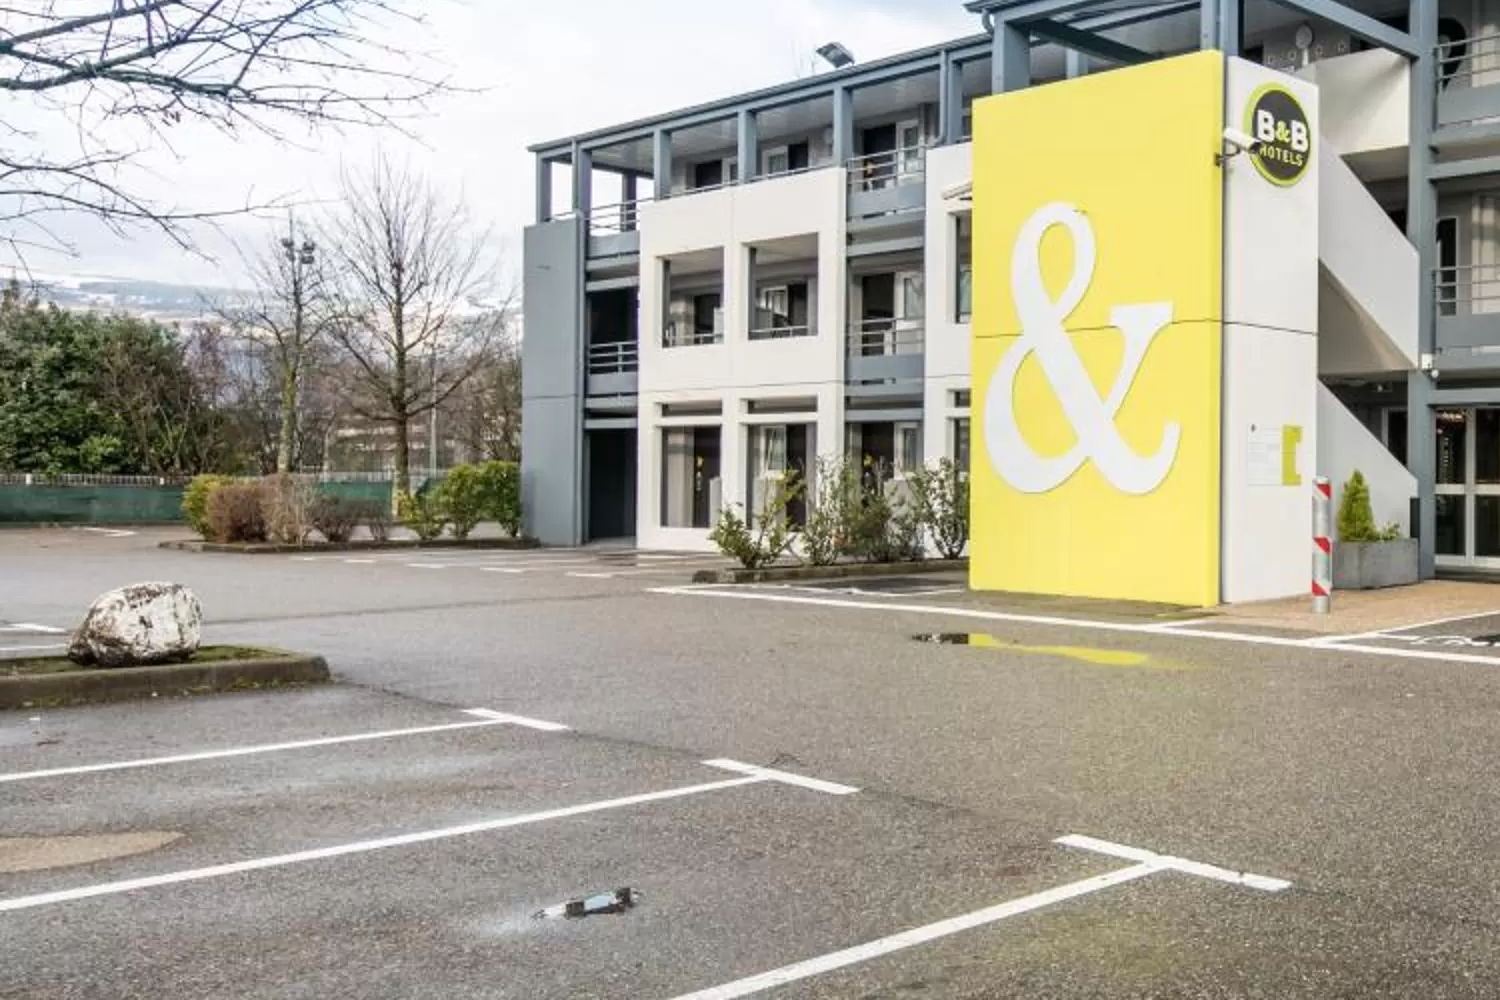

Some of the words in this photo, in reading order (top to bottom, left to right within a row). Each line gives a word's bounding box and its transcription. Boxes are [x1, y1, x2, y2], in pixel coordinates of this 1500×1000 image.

[1257, 109, 1309, 153] B&B
[1260, 143, 1304, 167] HOTELS
[983, 200, 1182, 496] &
